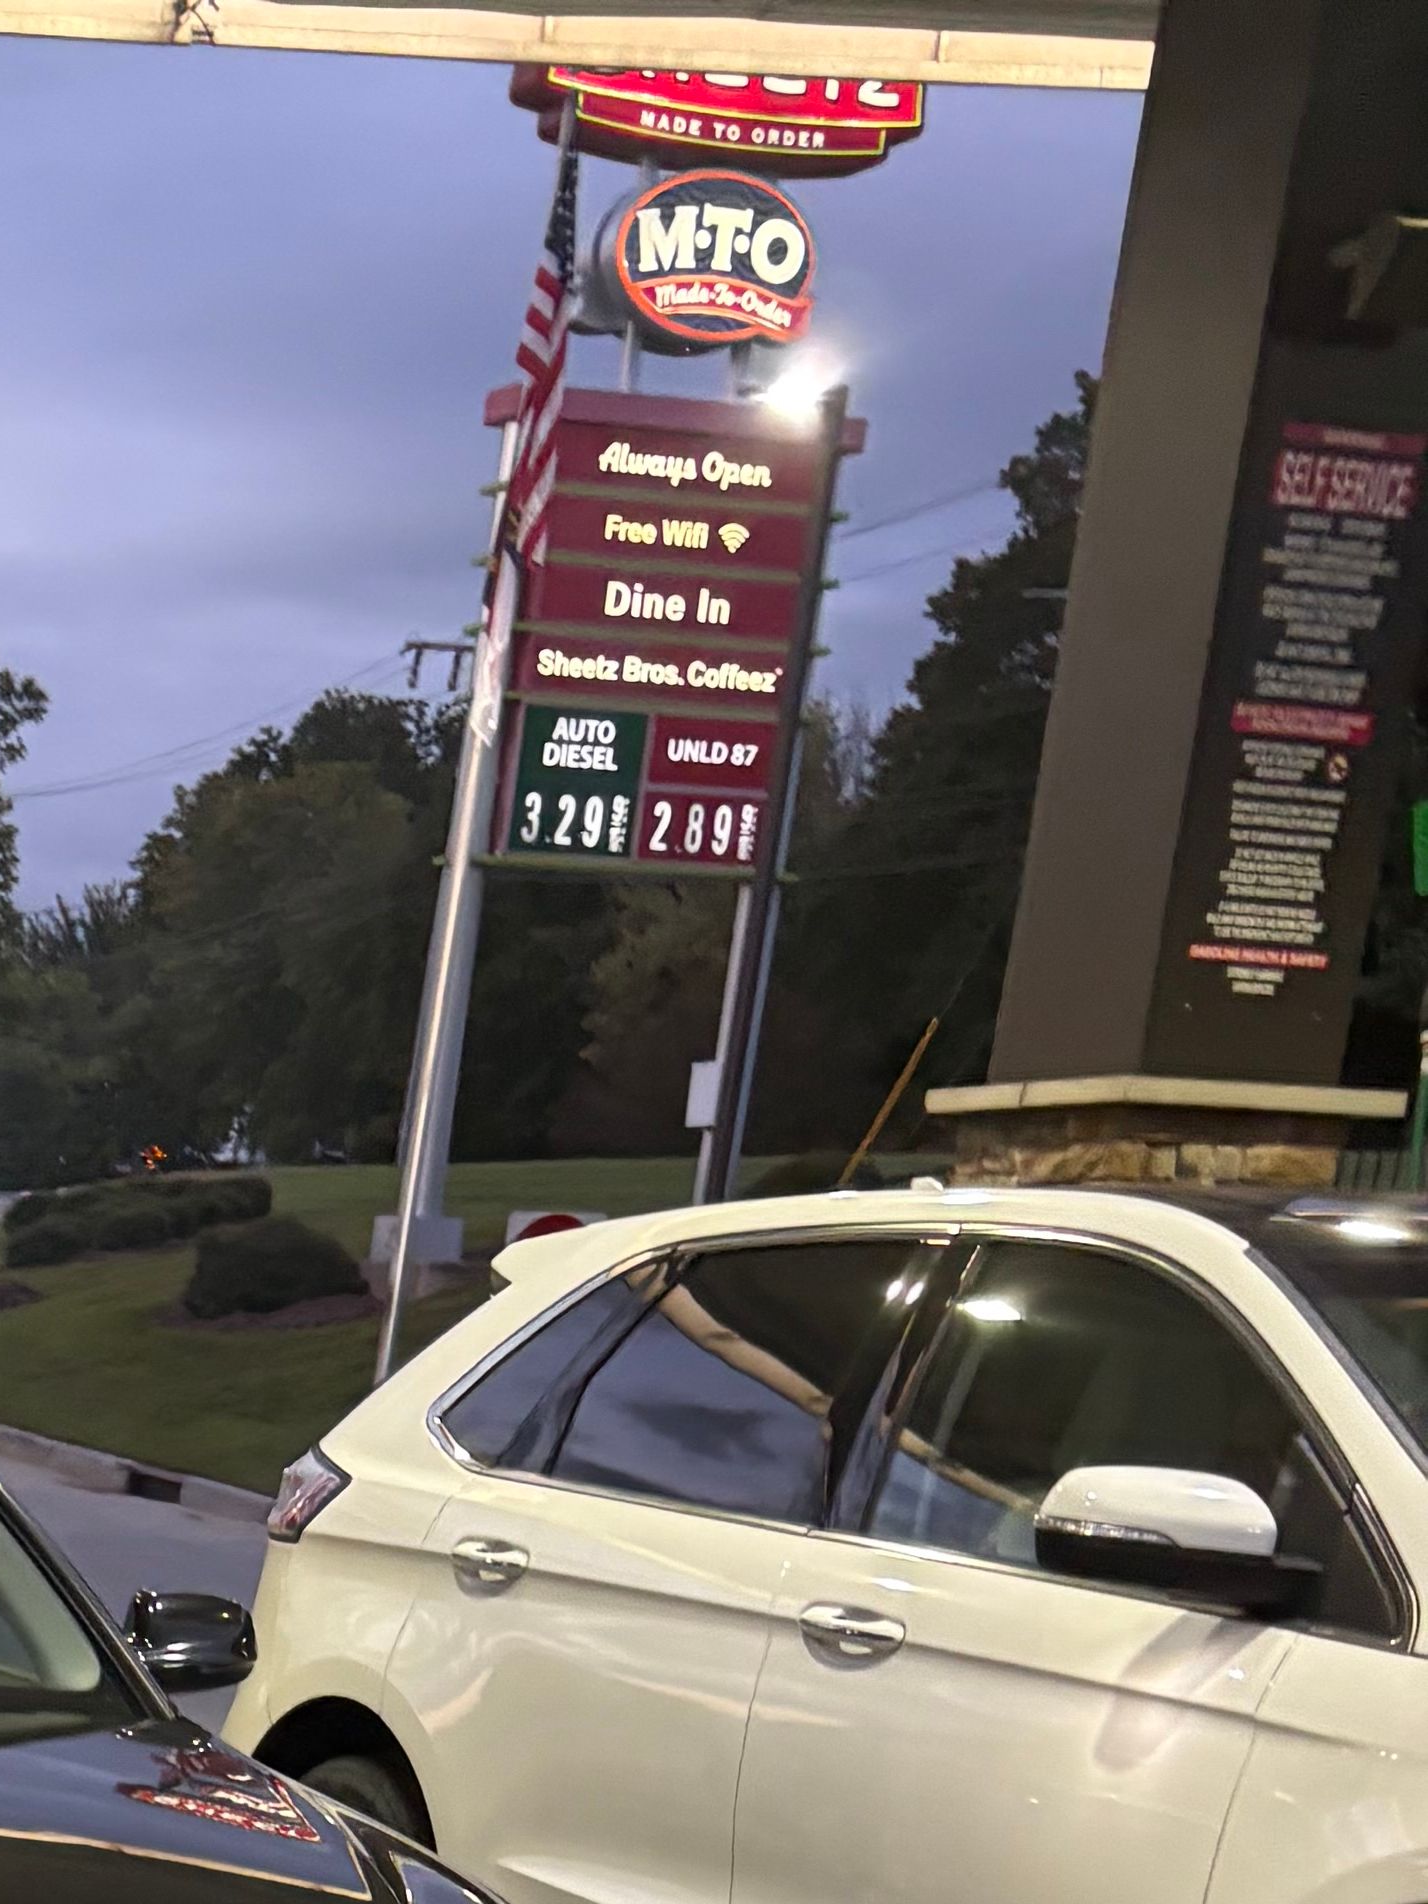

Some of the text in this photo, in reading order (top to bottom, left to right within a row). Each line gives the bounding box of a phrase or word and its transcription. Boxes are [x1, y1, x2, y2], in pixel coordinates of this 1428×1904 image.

[639, 110, 826, 149] MADE TO ORDER
[598, 441, 773, 491] Always Open
[603, 513, 710, 550] Free Wifi
[603, 580, 732, 626] Dine In
[536, 648, 620, 682] Sheetz
[622, 655, 685, 687] Bros.
[552, 716, 616, 745] AUTO
[542, 742, 619, 772] DIESEL
[667, 738, 759, 767] UNLD 87
